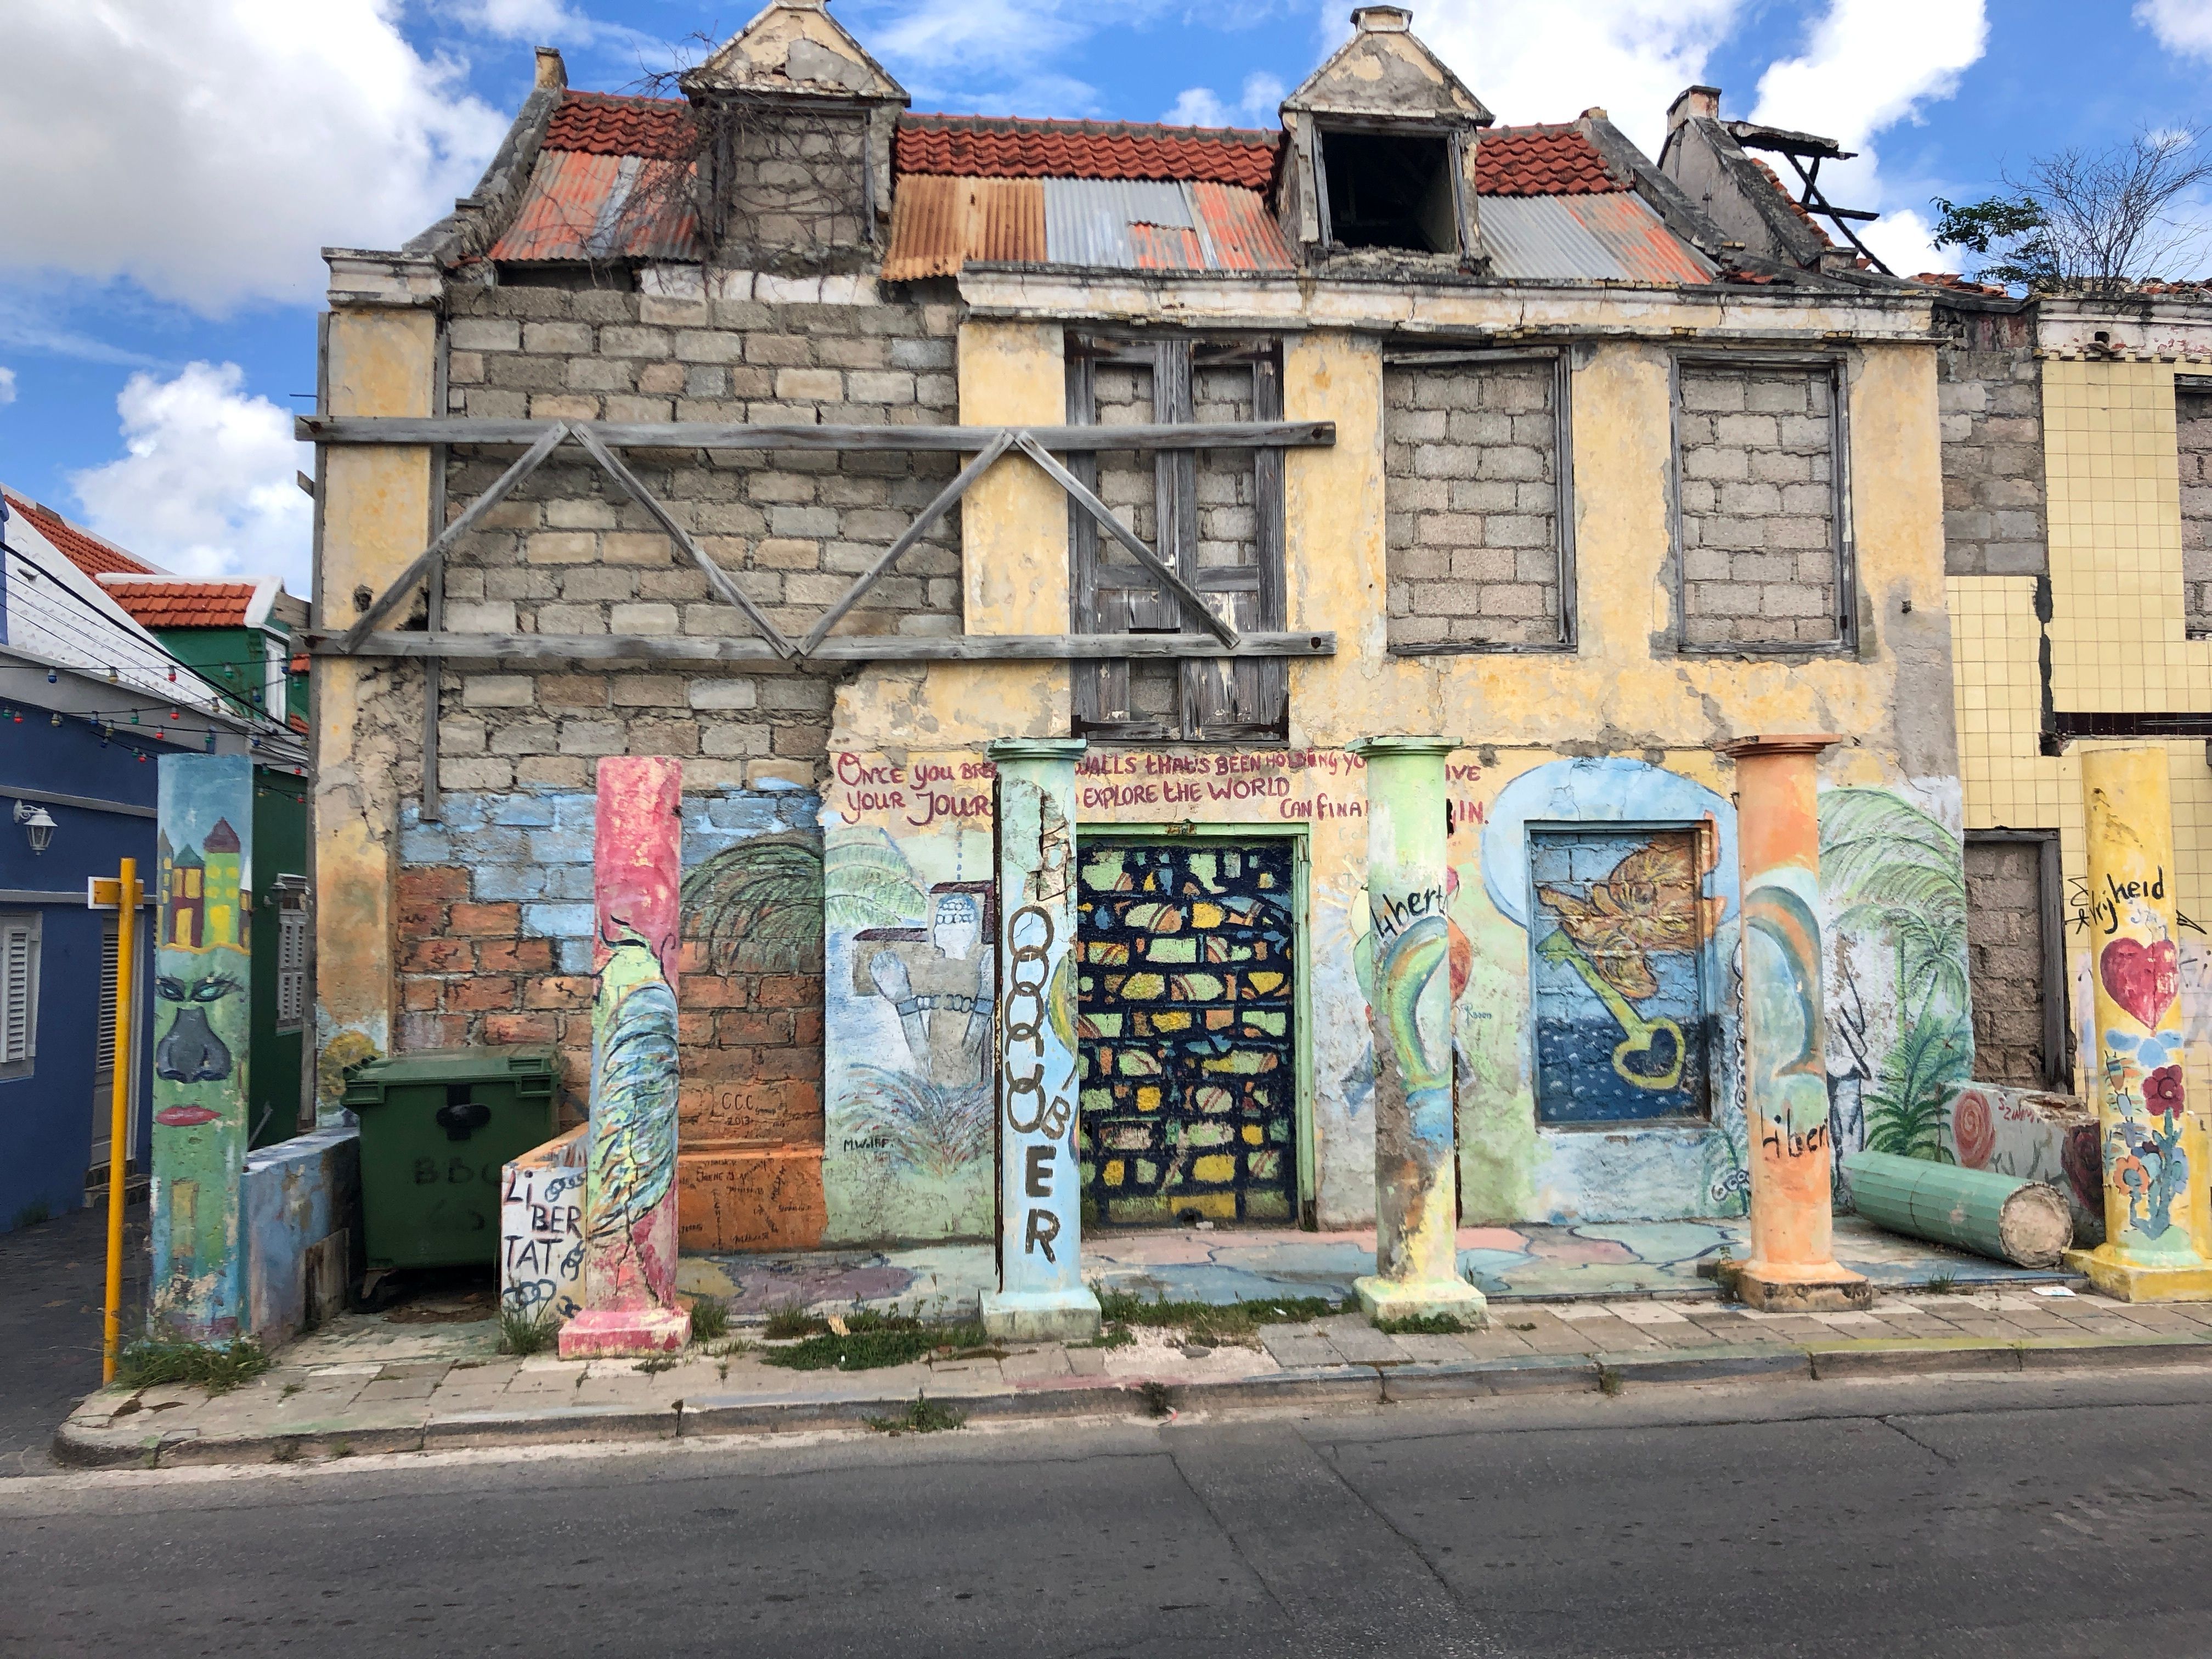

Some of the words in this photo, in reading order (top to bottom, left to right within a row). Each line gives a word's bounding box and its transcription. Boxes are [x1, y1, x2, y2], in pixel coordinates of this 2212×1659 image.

[1084, 785, 1159, 809] EXPLORE
[1207, 777, 1290, 801] WORLD
[1280, 798, 1312, 819] CAN
[504, 1234, 563, 1276] TAT
